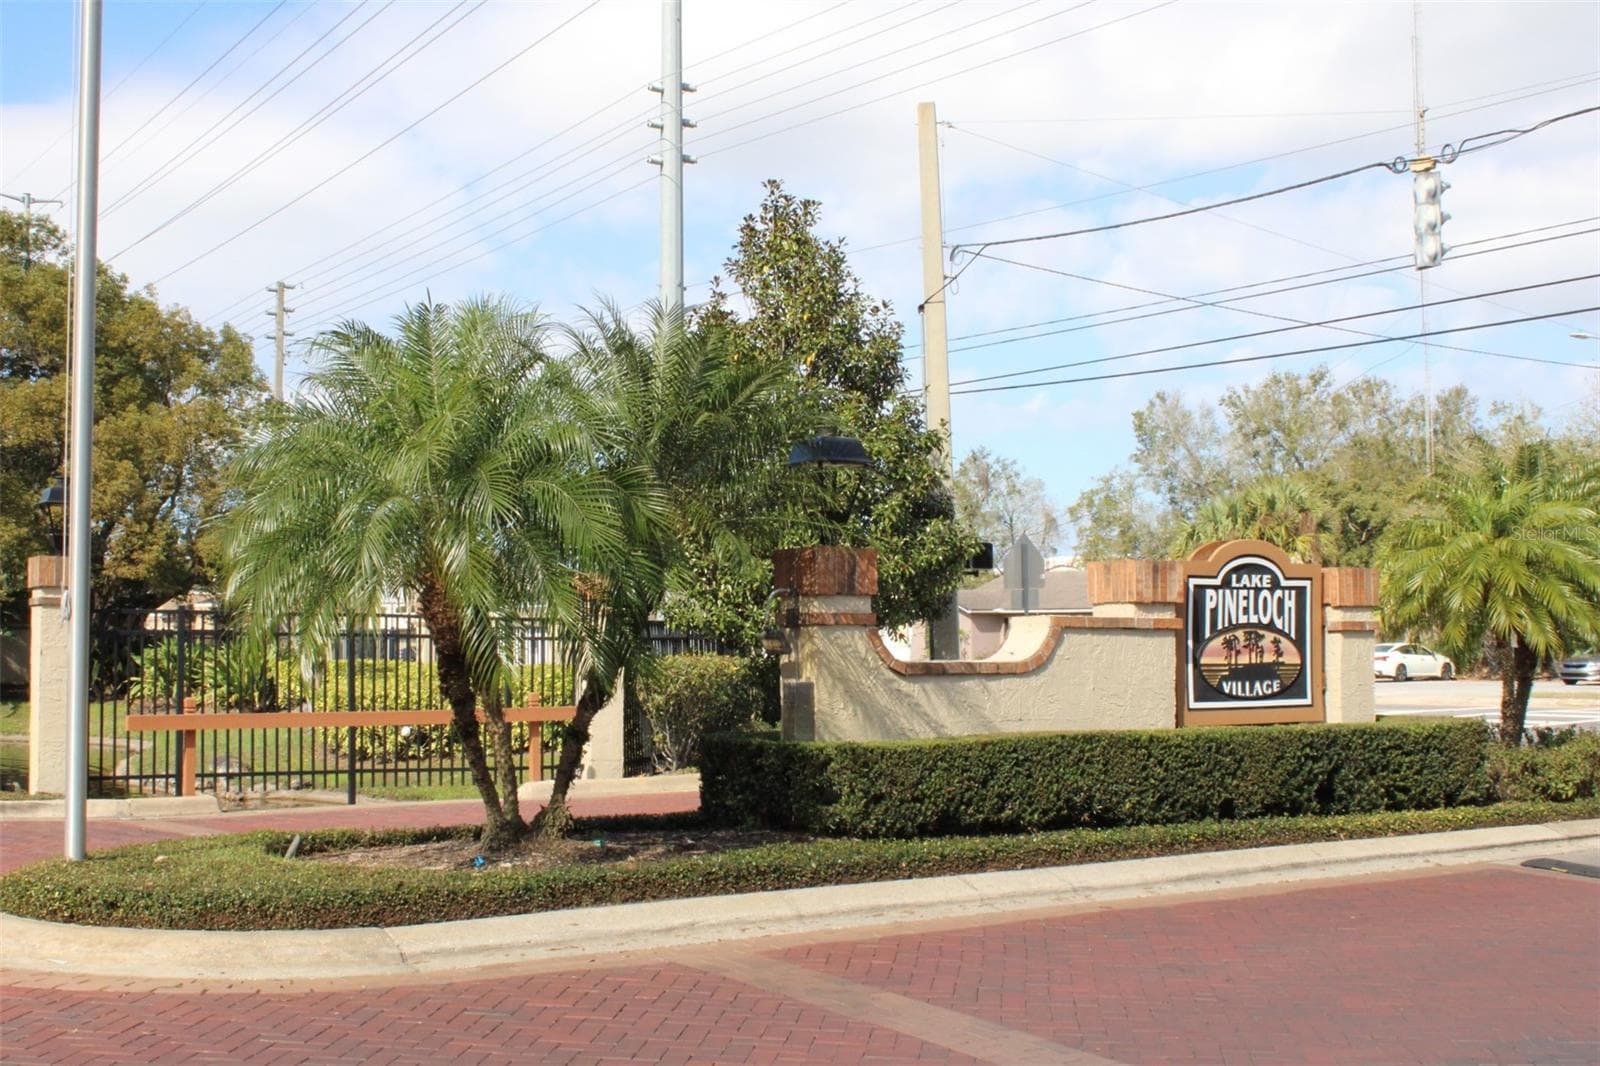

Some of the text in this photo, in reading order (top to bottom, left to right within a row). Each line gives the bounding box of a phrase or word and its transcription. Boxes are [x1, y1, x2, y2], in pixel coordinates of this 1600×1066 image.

[1231, 574, 1272, 588] LAKE
[1205, 588, 1297, 640] PINELOCH
[1222, 680, 1281, 697] VILLAGE
